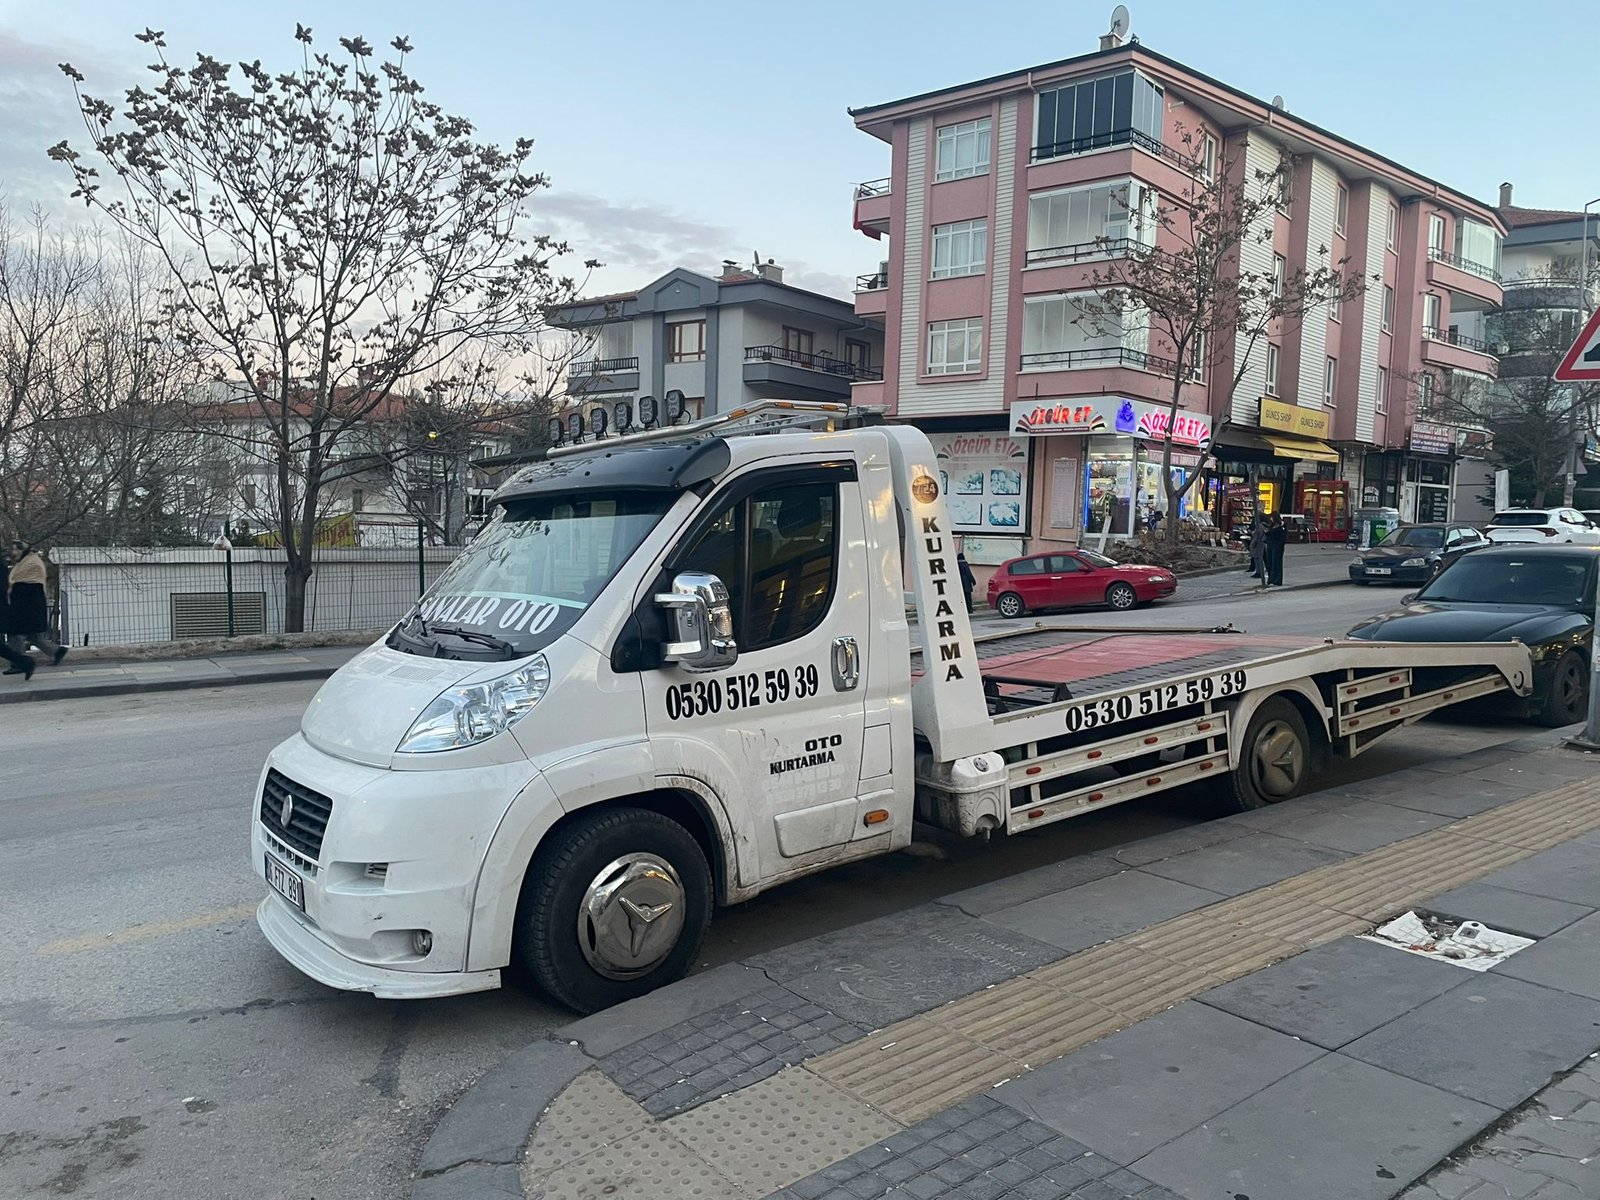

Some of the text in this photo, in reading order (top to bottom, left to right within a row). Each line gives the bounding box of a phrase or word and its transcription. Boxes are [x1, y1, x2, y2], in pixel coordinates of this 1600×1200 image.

[1029, 404, 1091, 425] ÖZGÜR ET
[1280, 412, 1292, 423] SHOP
[1313, 420, 1325, 430] SHOP
[1187, 418, 1201, 437] ET
[954, 434, 1009, 455] ÖZGÜR ET
[921, 516, 964, 683] KURTARMA
[499, 599, 560, 635] OTO
[666, 663, 819, 720] 0530 512 59 39
[1065, 669, 1247, 732] 0530 512 59 39
[805, 734, 842, 752] OTO
[769, 750, 836, 775] KURTARMA
[964, 931, 1027, 957] ANKARA
